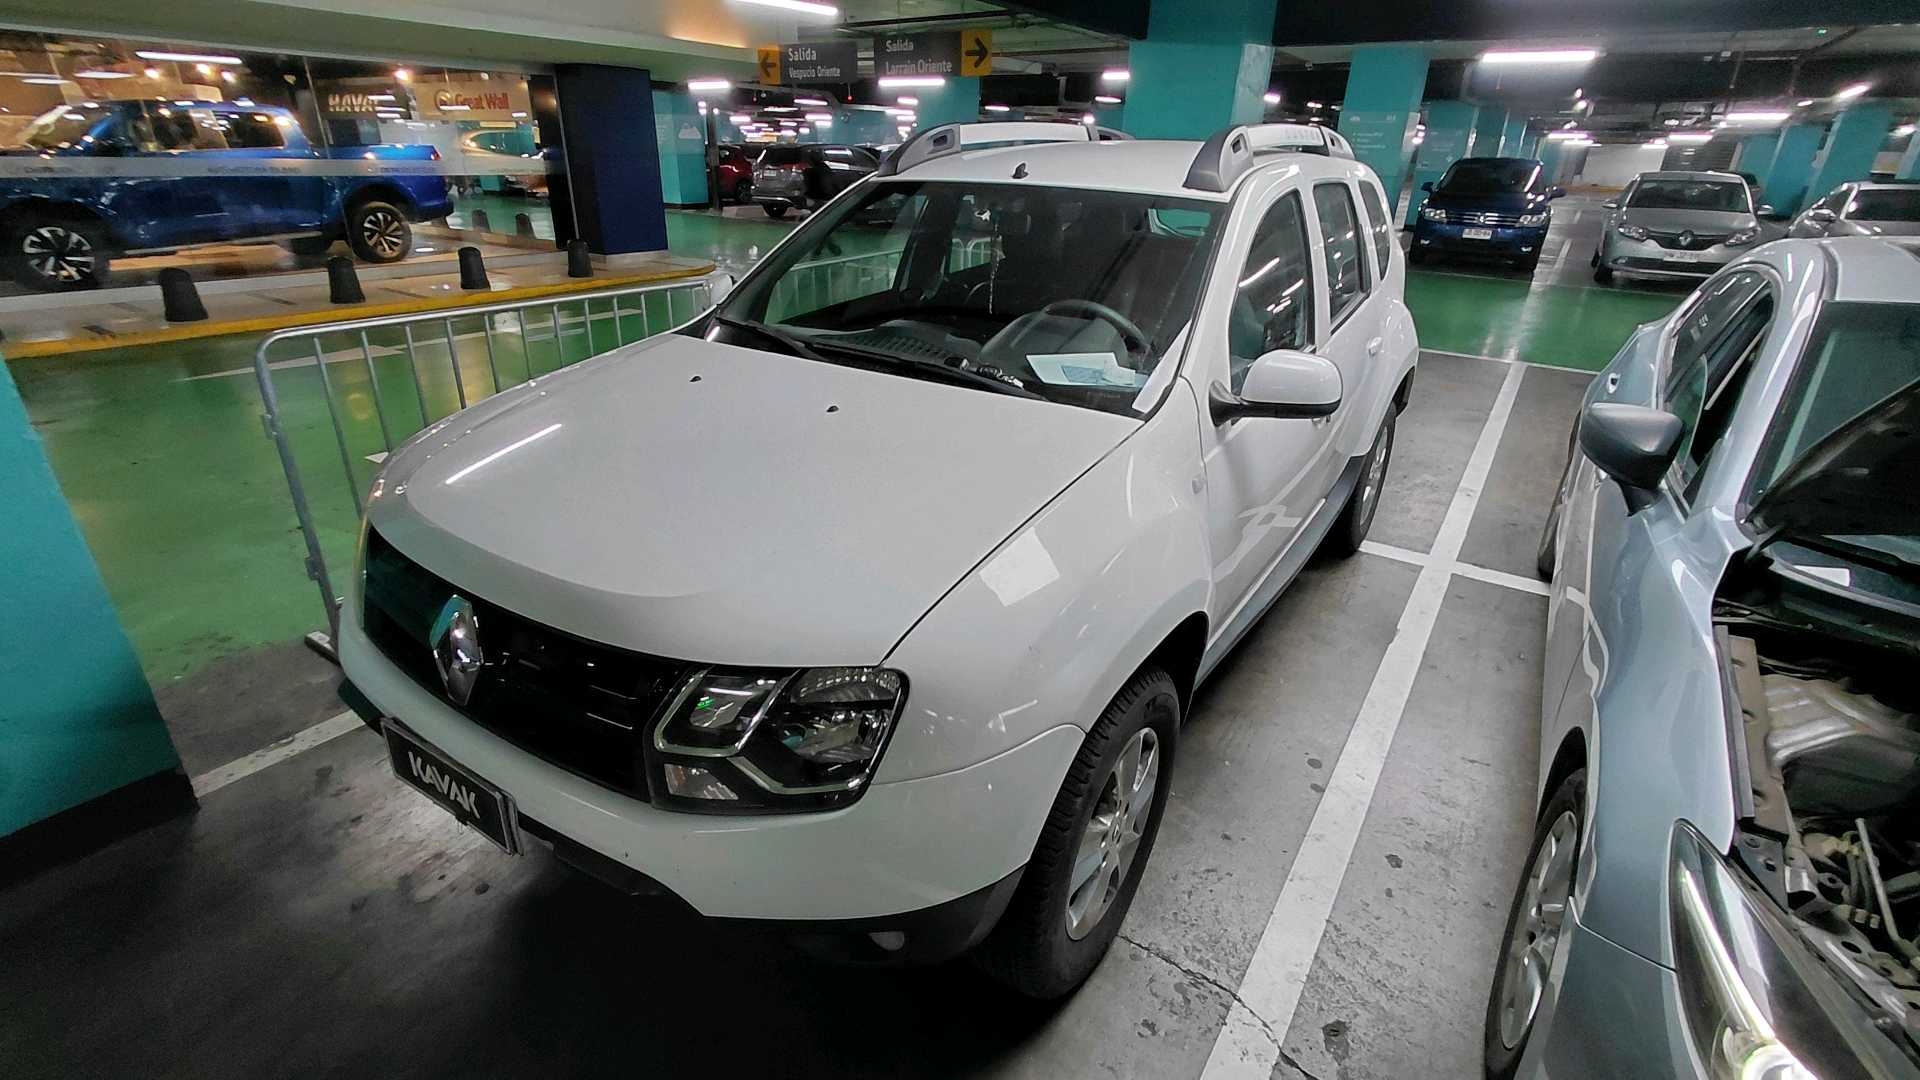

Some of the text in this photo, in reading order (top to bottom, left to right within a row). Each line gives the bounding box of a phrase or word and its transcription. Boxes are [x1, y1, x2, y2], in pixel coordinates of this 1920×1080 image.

[885, 39, 914, 52] Salida
[788, 47, 817, 61] Salida
[788, 65, 841, 80] Vespucio Oriente
[917, 58, 953, 73] Oriente
[455, 92, 510, 110] Great Wall
[409, 751, 481, 820] KAVAK
